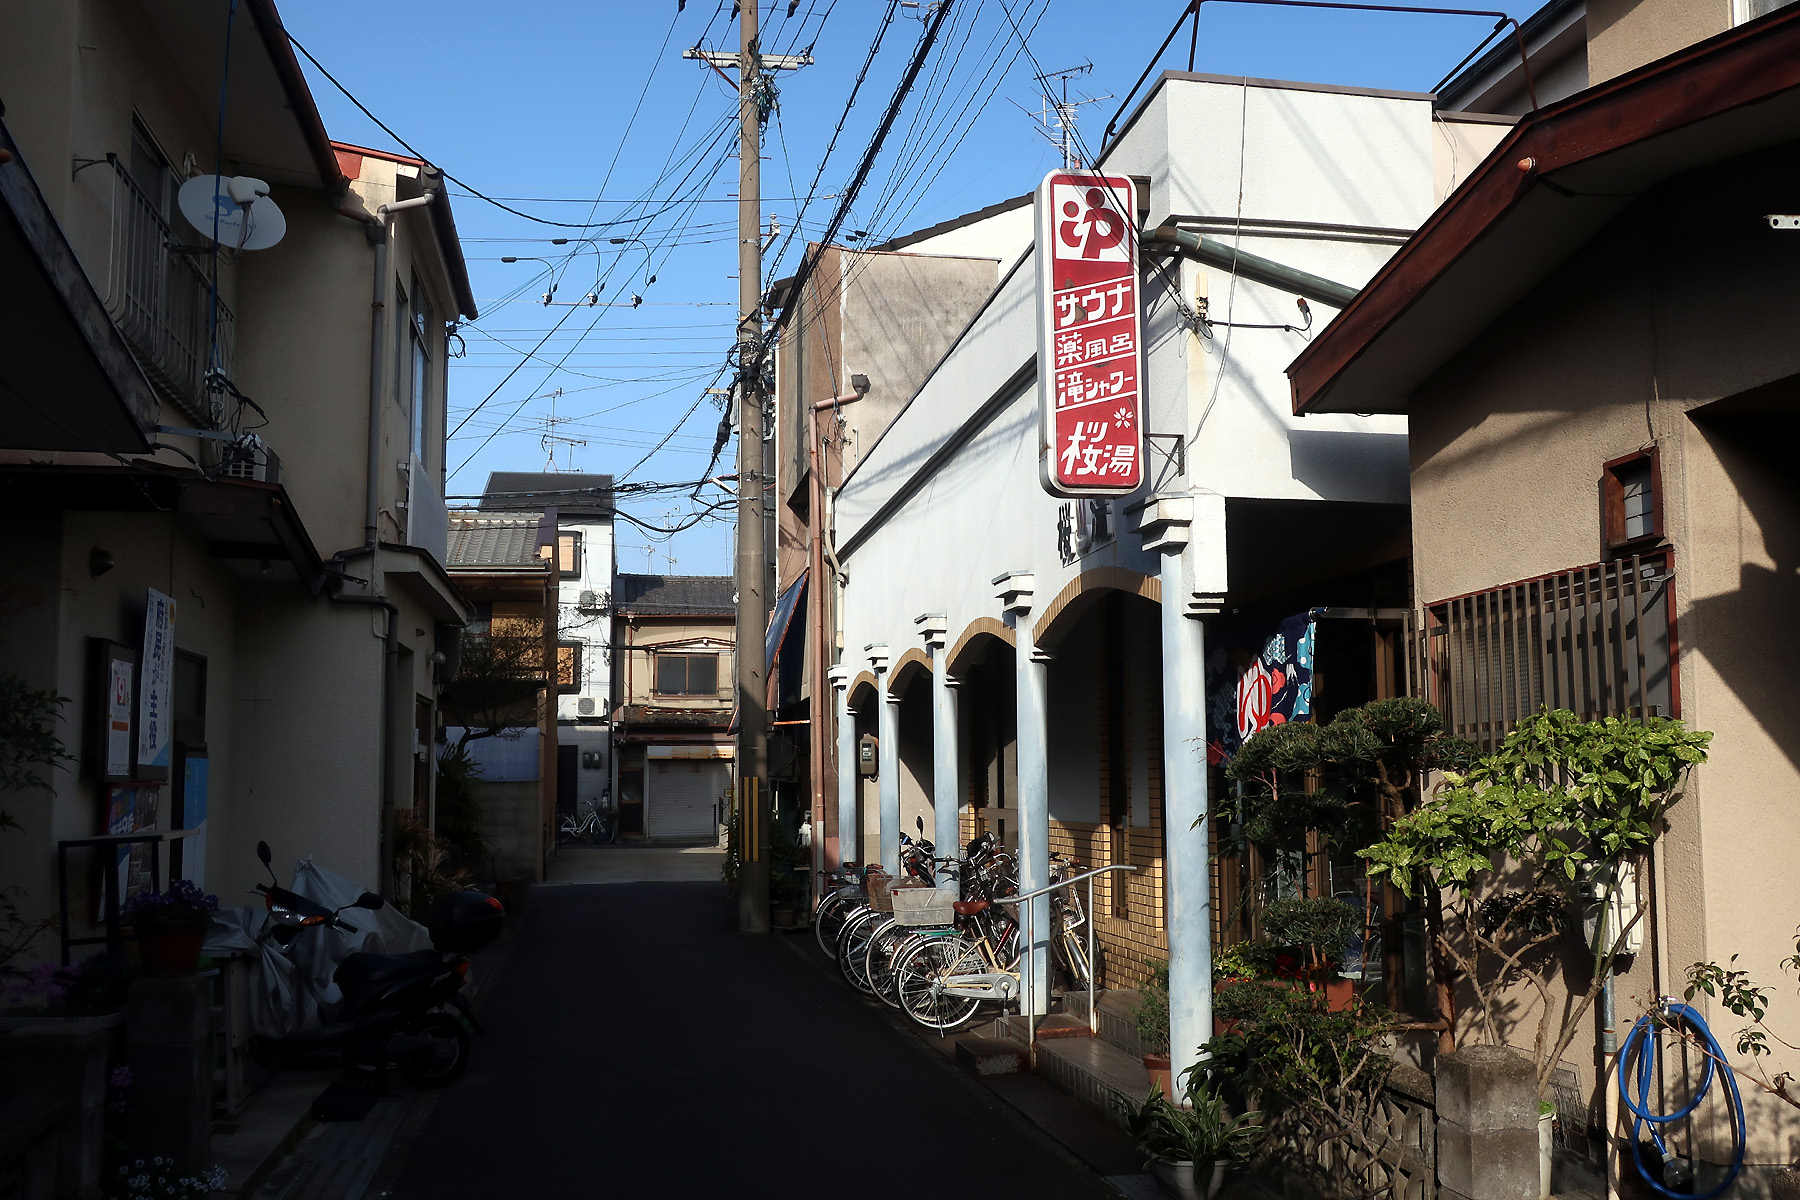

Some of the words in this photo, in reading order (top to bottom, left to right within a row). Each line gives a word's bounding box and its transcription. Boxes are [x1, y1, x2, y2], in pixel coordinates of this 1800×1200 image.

[1057, 283, 1133, 327] サウナ
[1057, 331, 1134, 367] 薬風呂
[1058, 372, 1134, 407] 滝シャワー
[1061, 421, 1136, 477] 桜湯
[1238, 657, 1273, 736] ゆ
